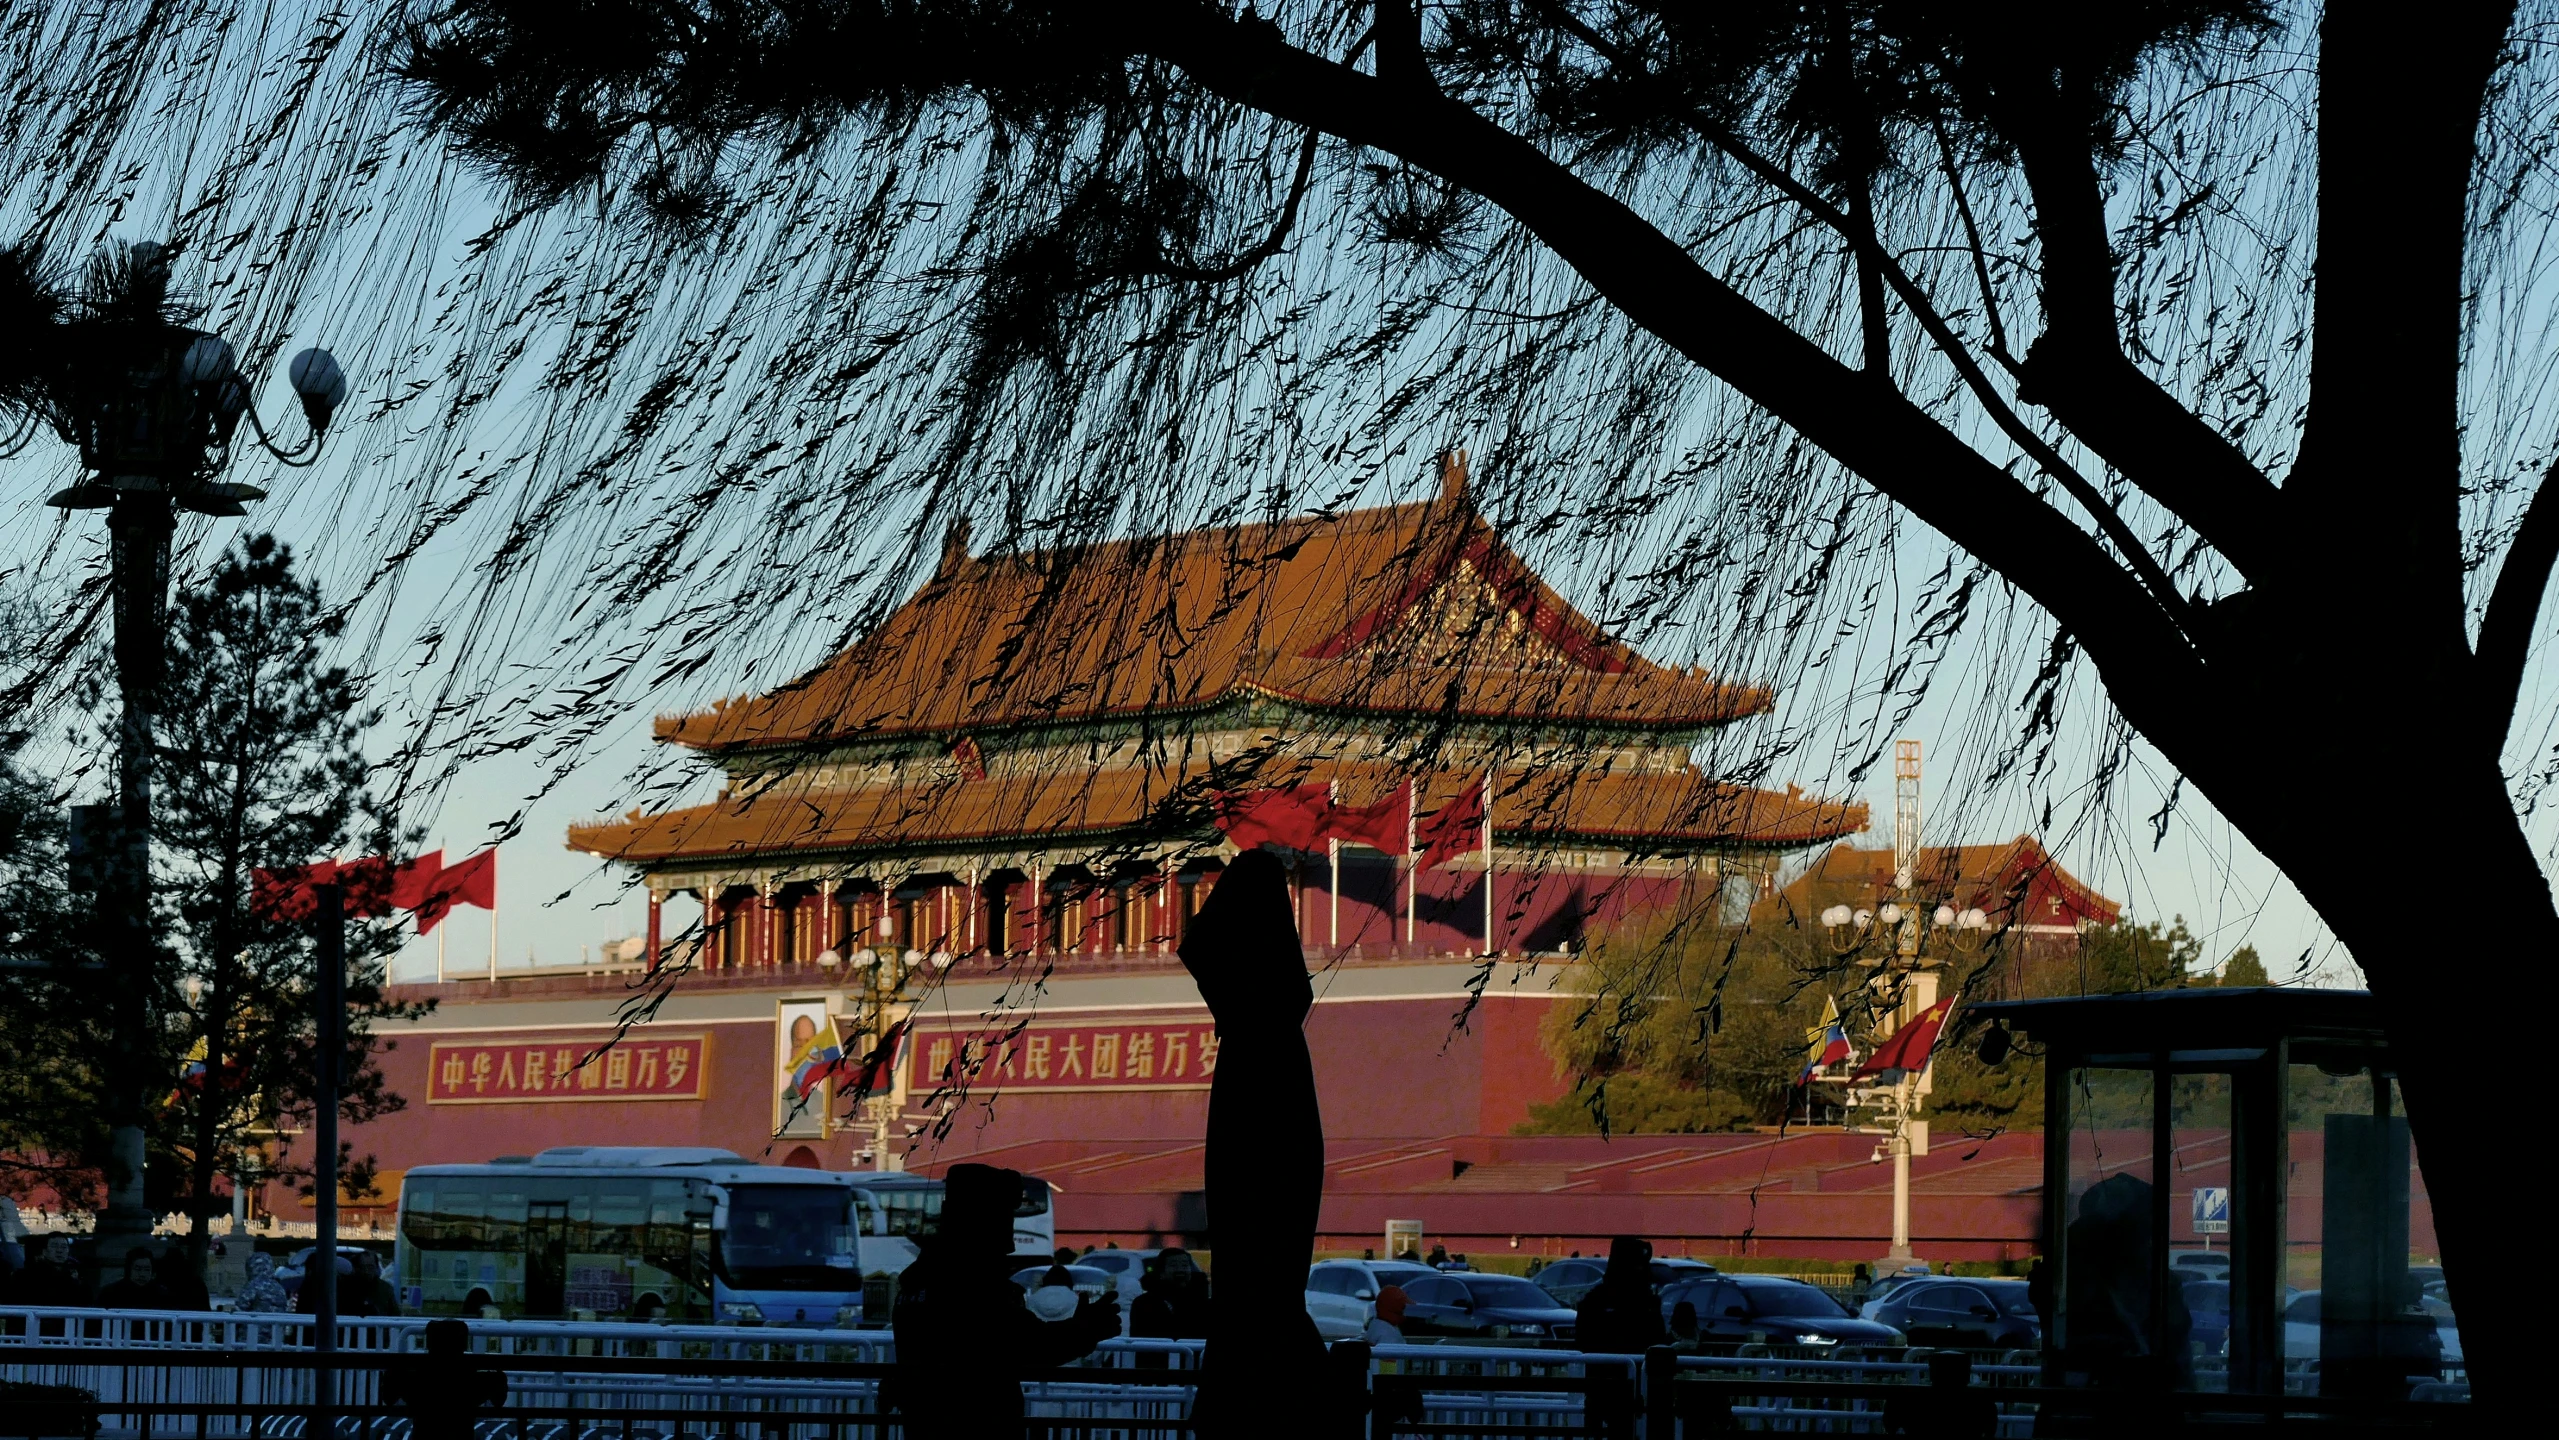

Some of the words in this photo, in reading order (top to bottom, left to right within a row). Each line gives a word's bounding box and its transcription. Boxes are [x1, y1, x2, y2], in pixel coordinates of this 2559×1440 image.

[442, 1047, 690, 1093] 中华人民共和国万岁
